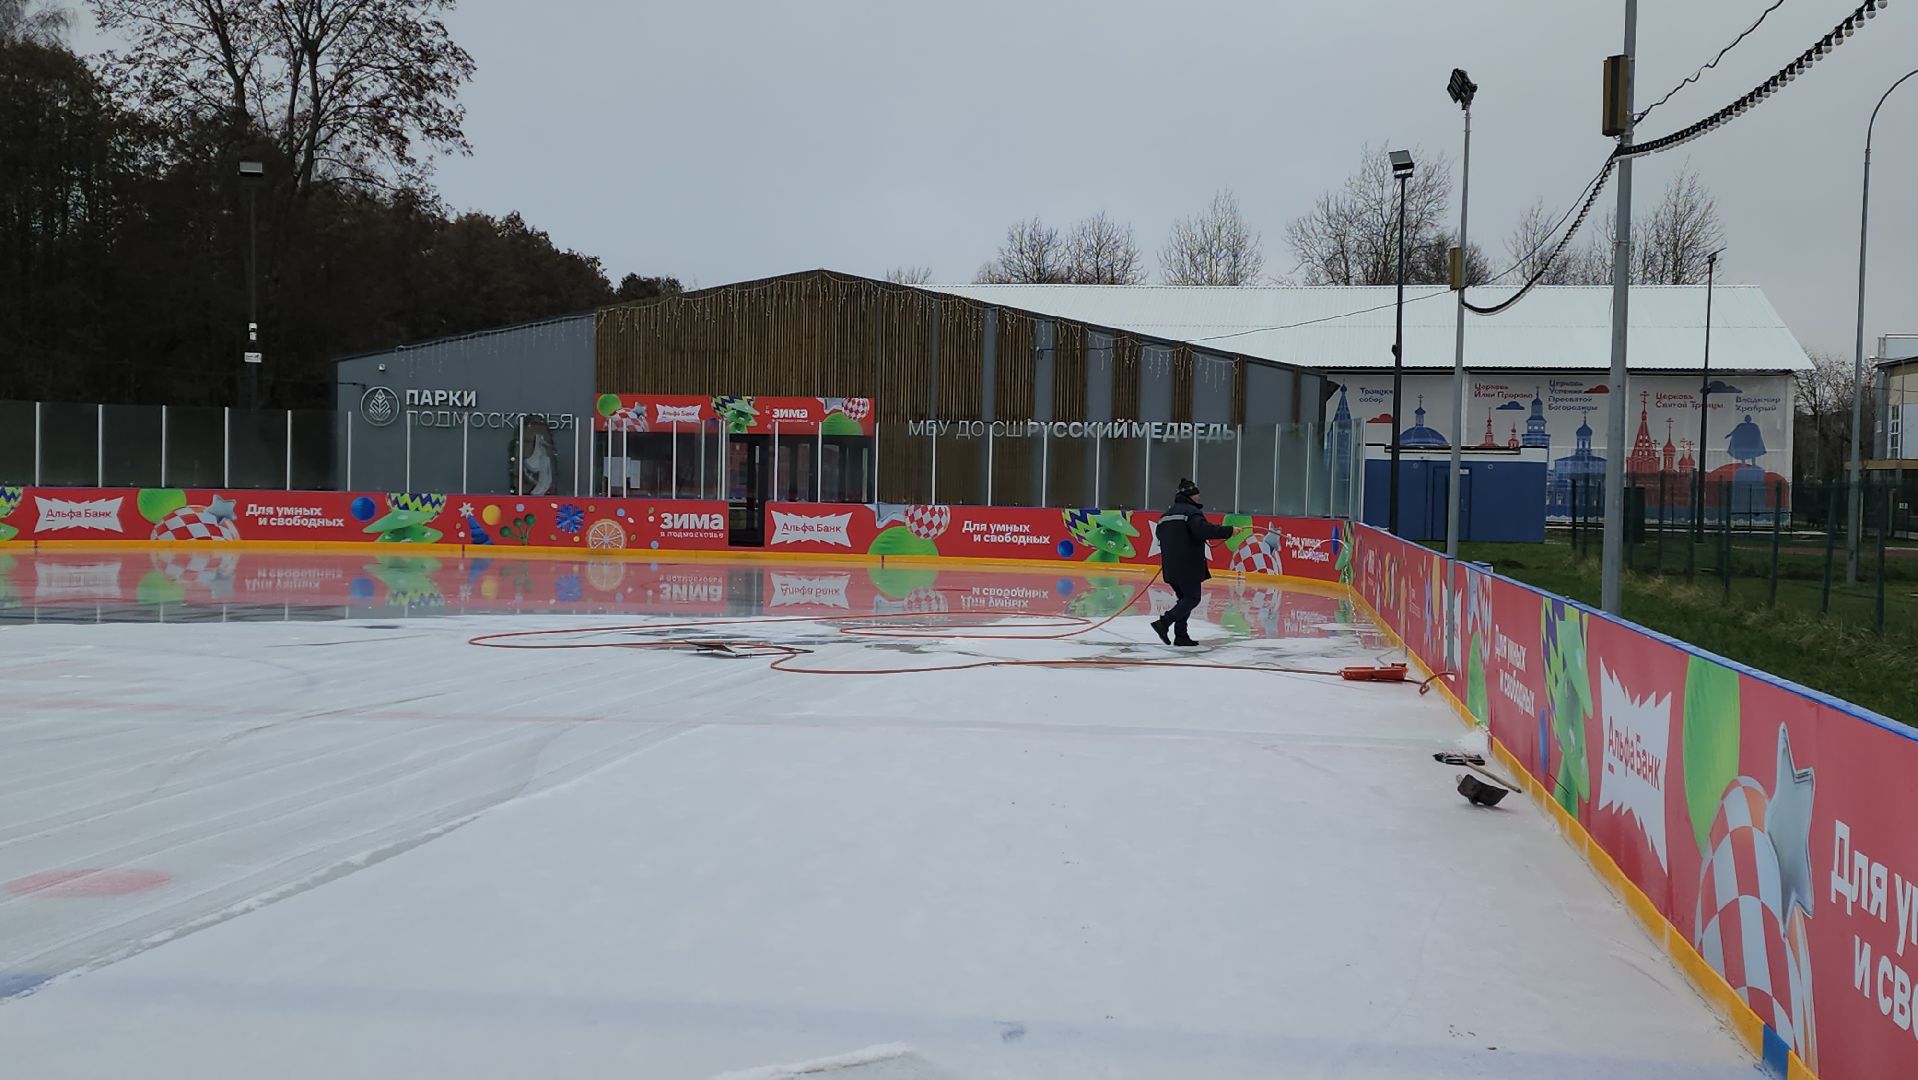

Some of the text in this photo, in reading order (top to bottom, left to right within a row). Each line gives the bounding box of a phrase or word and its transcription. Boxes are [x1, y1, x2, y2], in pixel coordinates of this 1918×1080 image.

[406, 389, 477, 407] ПАРКИ
[908, 418, 1236, 442] МБУ ДО СШ РУССКИЙ МЕДВЕДЬ
[46, 508, 112, 521] Альфа Банк
[245, 503, 323, 517] Для умных
[258, 516, 345, 528] и свободных
[781, 522, 842, 535] Альфа Банк
[962, 520, 1031, 534] Для умных
[973, 532, 1050, 546] и свободных
[1608, 715, 1660, 791] Альфа Банк
[1831, 819, 1888, 923] Для
[1854, 934, 1871, 999] и
